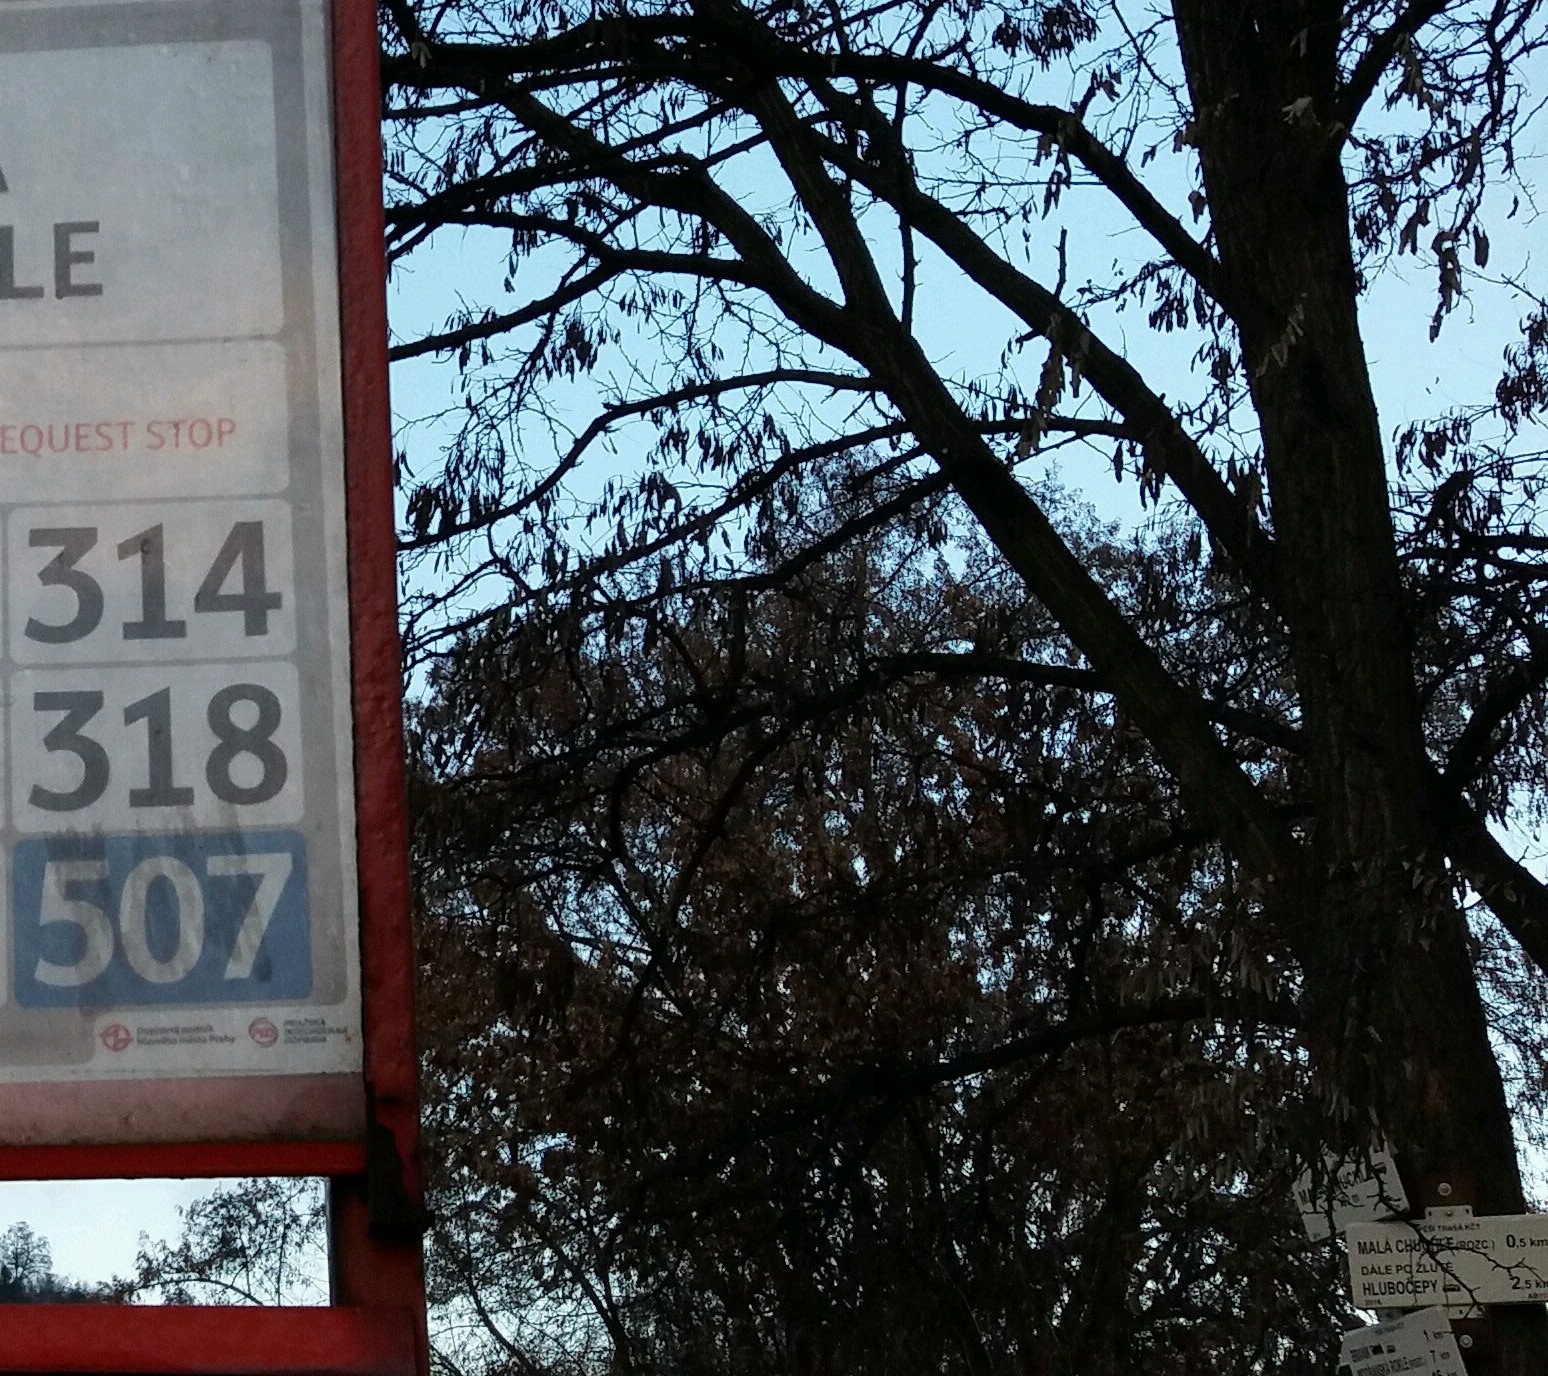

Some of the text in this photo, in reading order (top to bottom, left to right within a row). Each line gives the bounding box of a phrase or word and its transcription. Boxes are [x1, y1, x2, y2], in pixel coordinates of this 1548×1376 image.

[146, 418, 236, 450] STOP
[24, 521, 283, 644] 314
[29, 682, 290, 812] 318
[34, 852, 294, 987] 507
[1363, 1278, 1438, 1296] HLUBOČEPY
